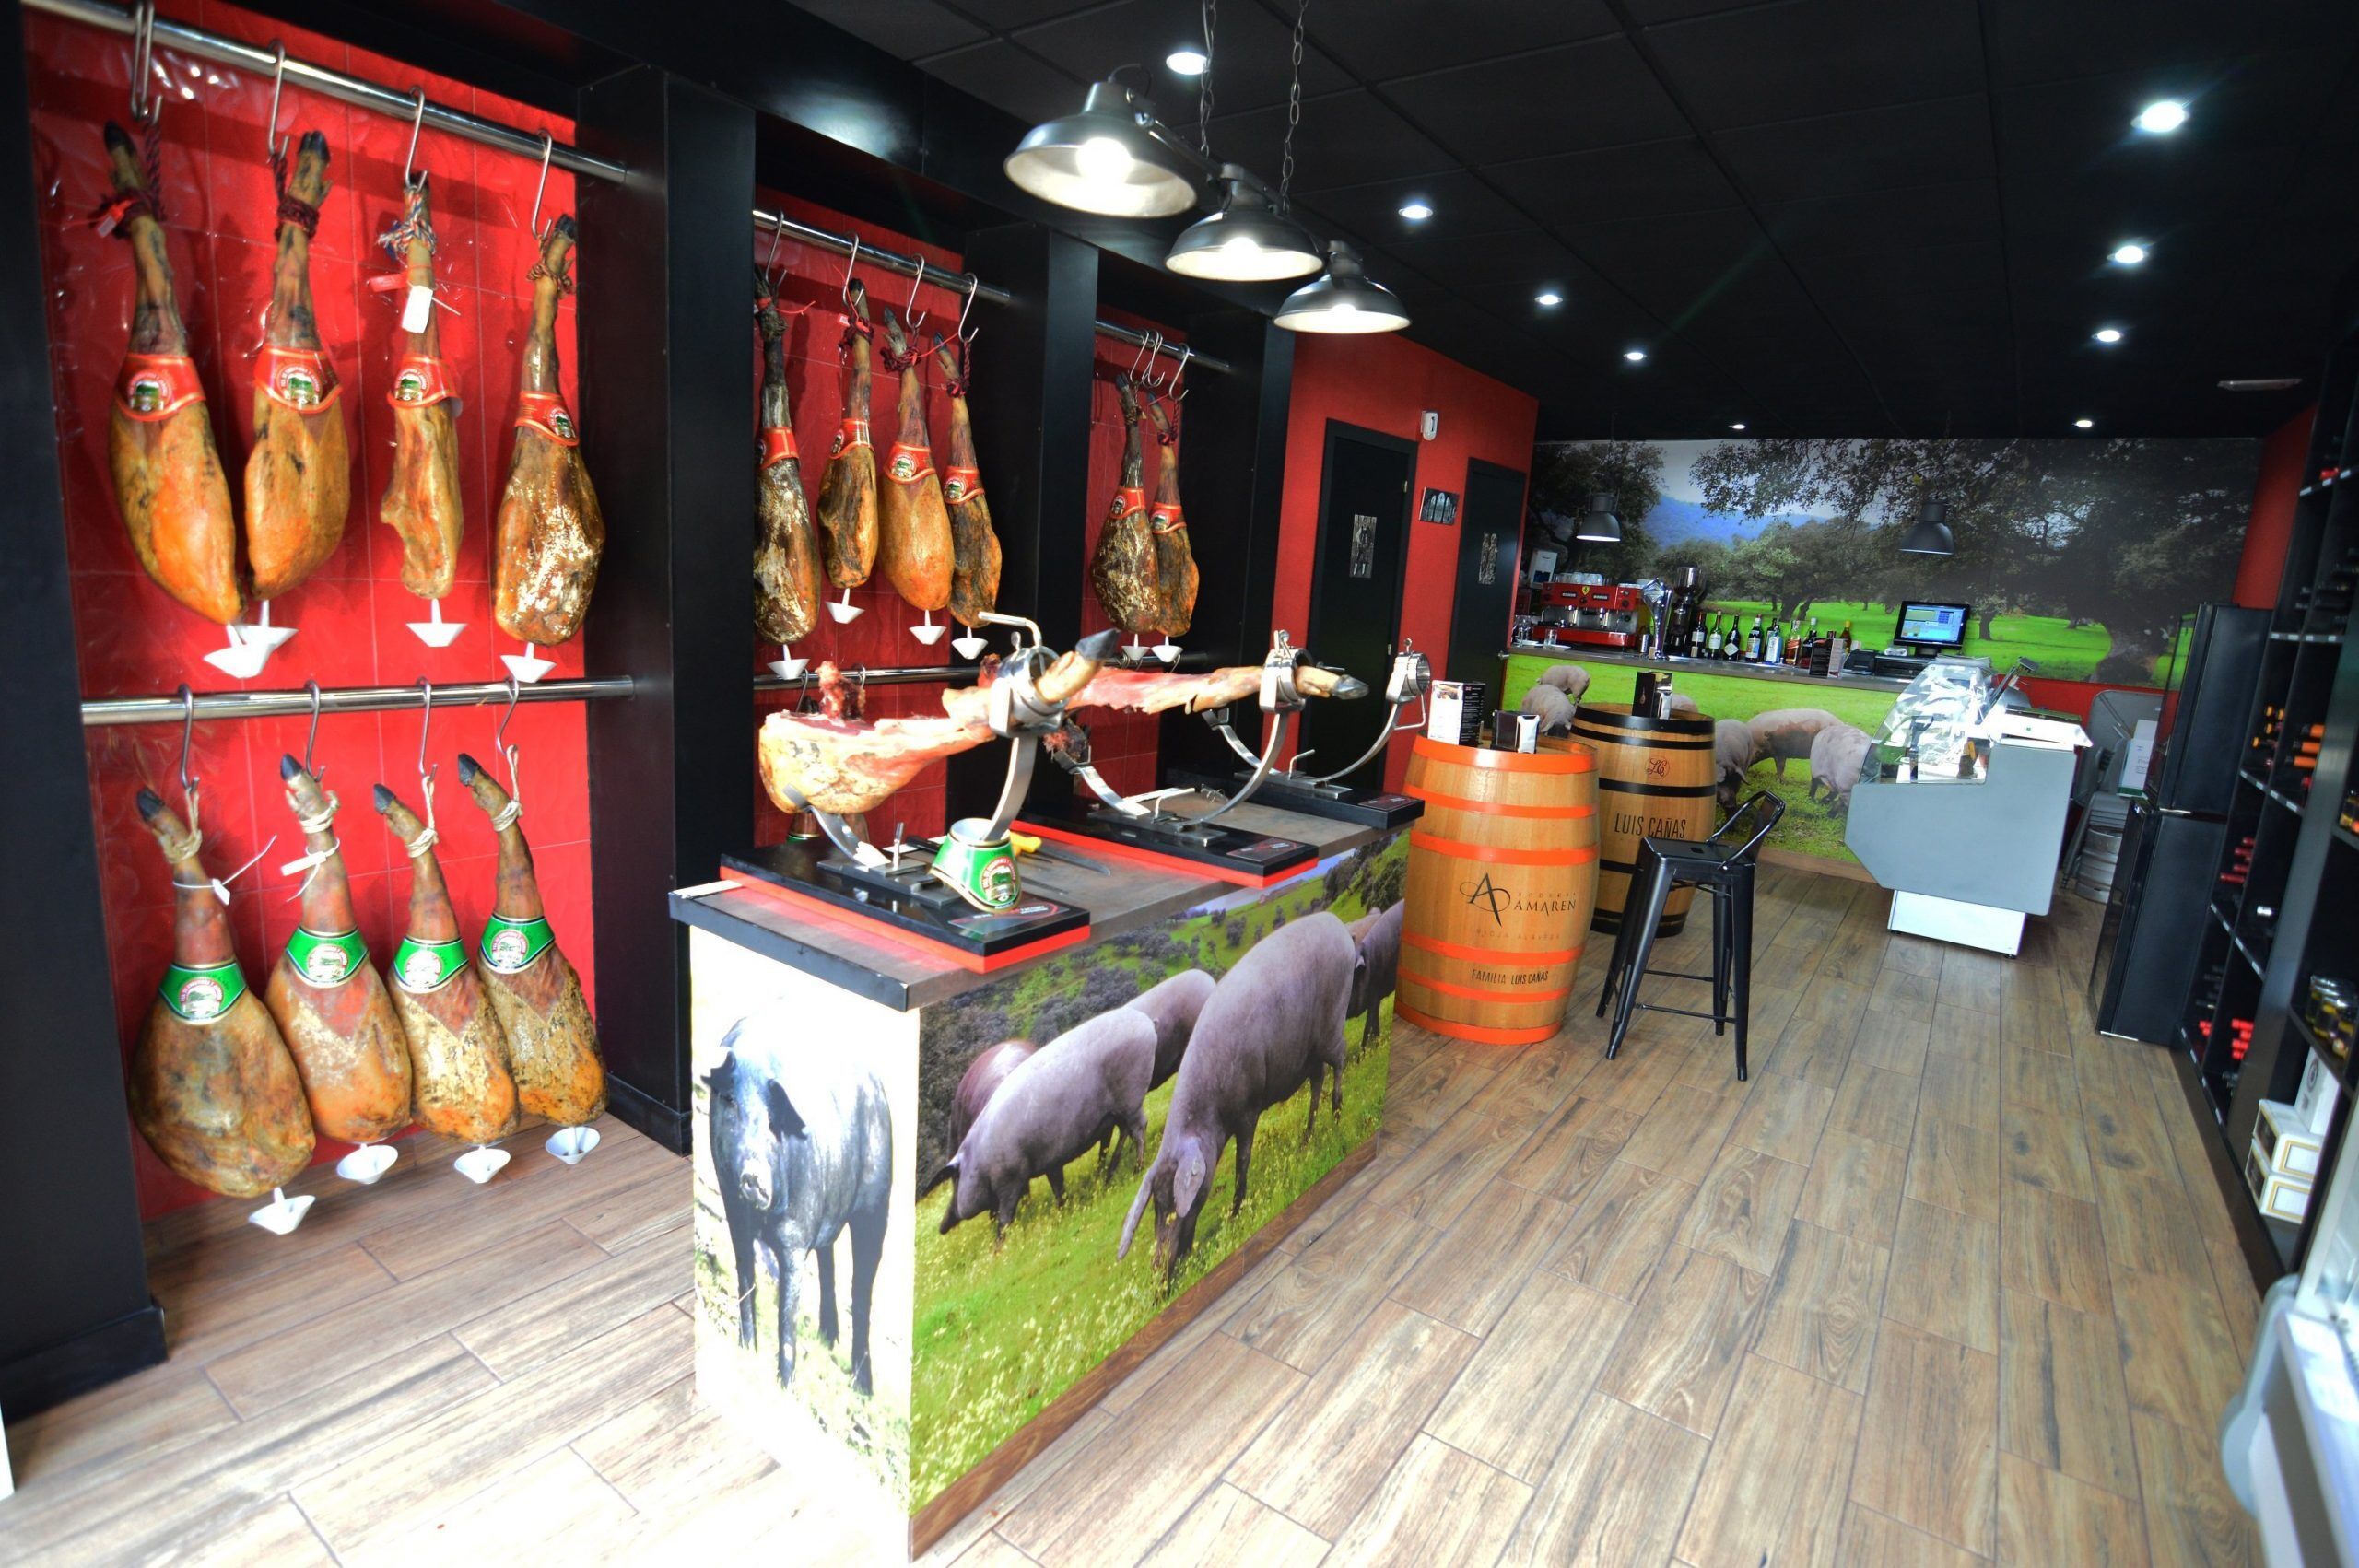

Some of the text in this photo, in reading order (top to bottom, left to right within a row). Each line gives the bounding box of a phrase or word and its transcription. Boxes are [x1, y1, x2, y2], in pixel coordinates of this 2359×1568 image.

[1614, 813, 1686, 839] LUIS CAÑAS
[1514, 899, 1577, 916] AMAREN
[1472, 969, 1506, 984] FAMILIA
[1511, 973, 1526, 985] LUIS
